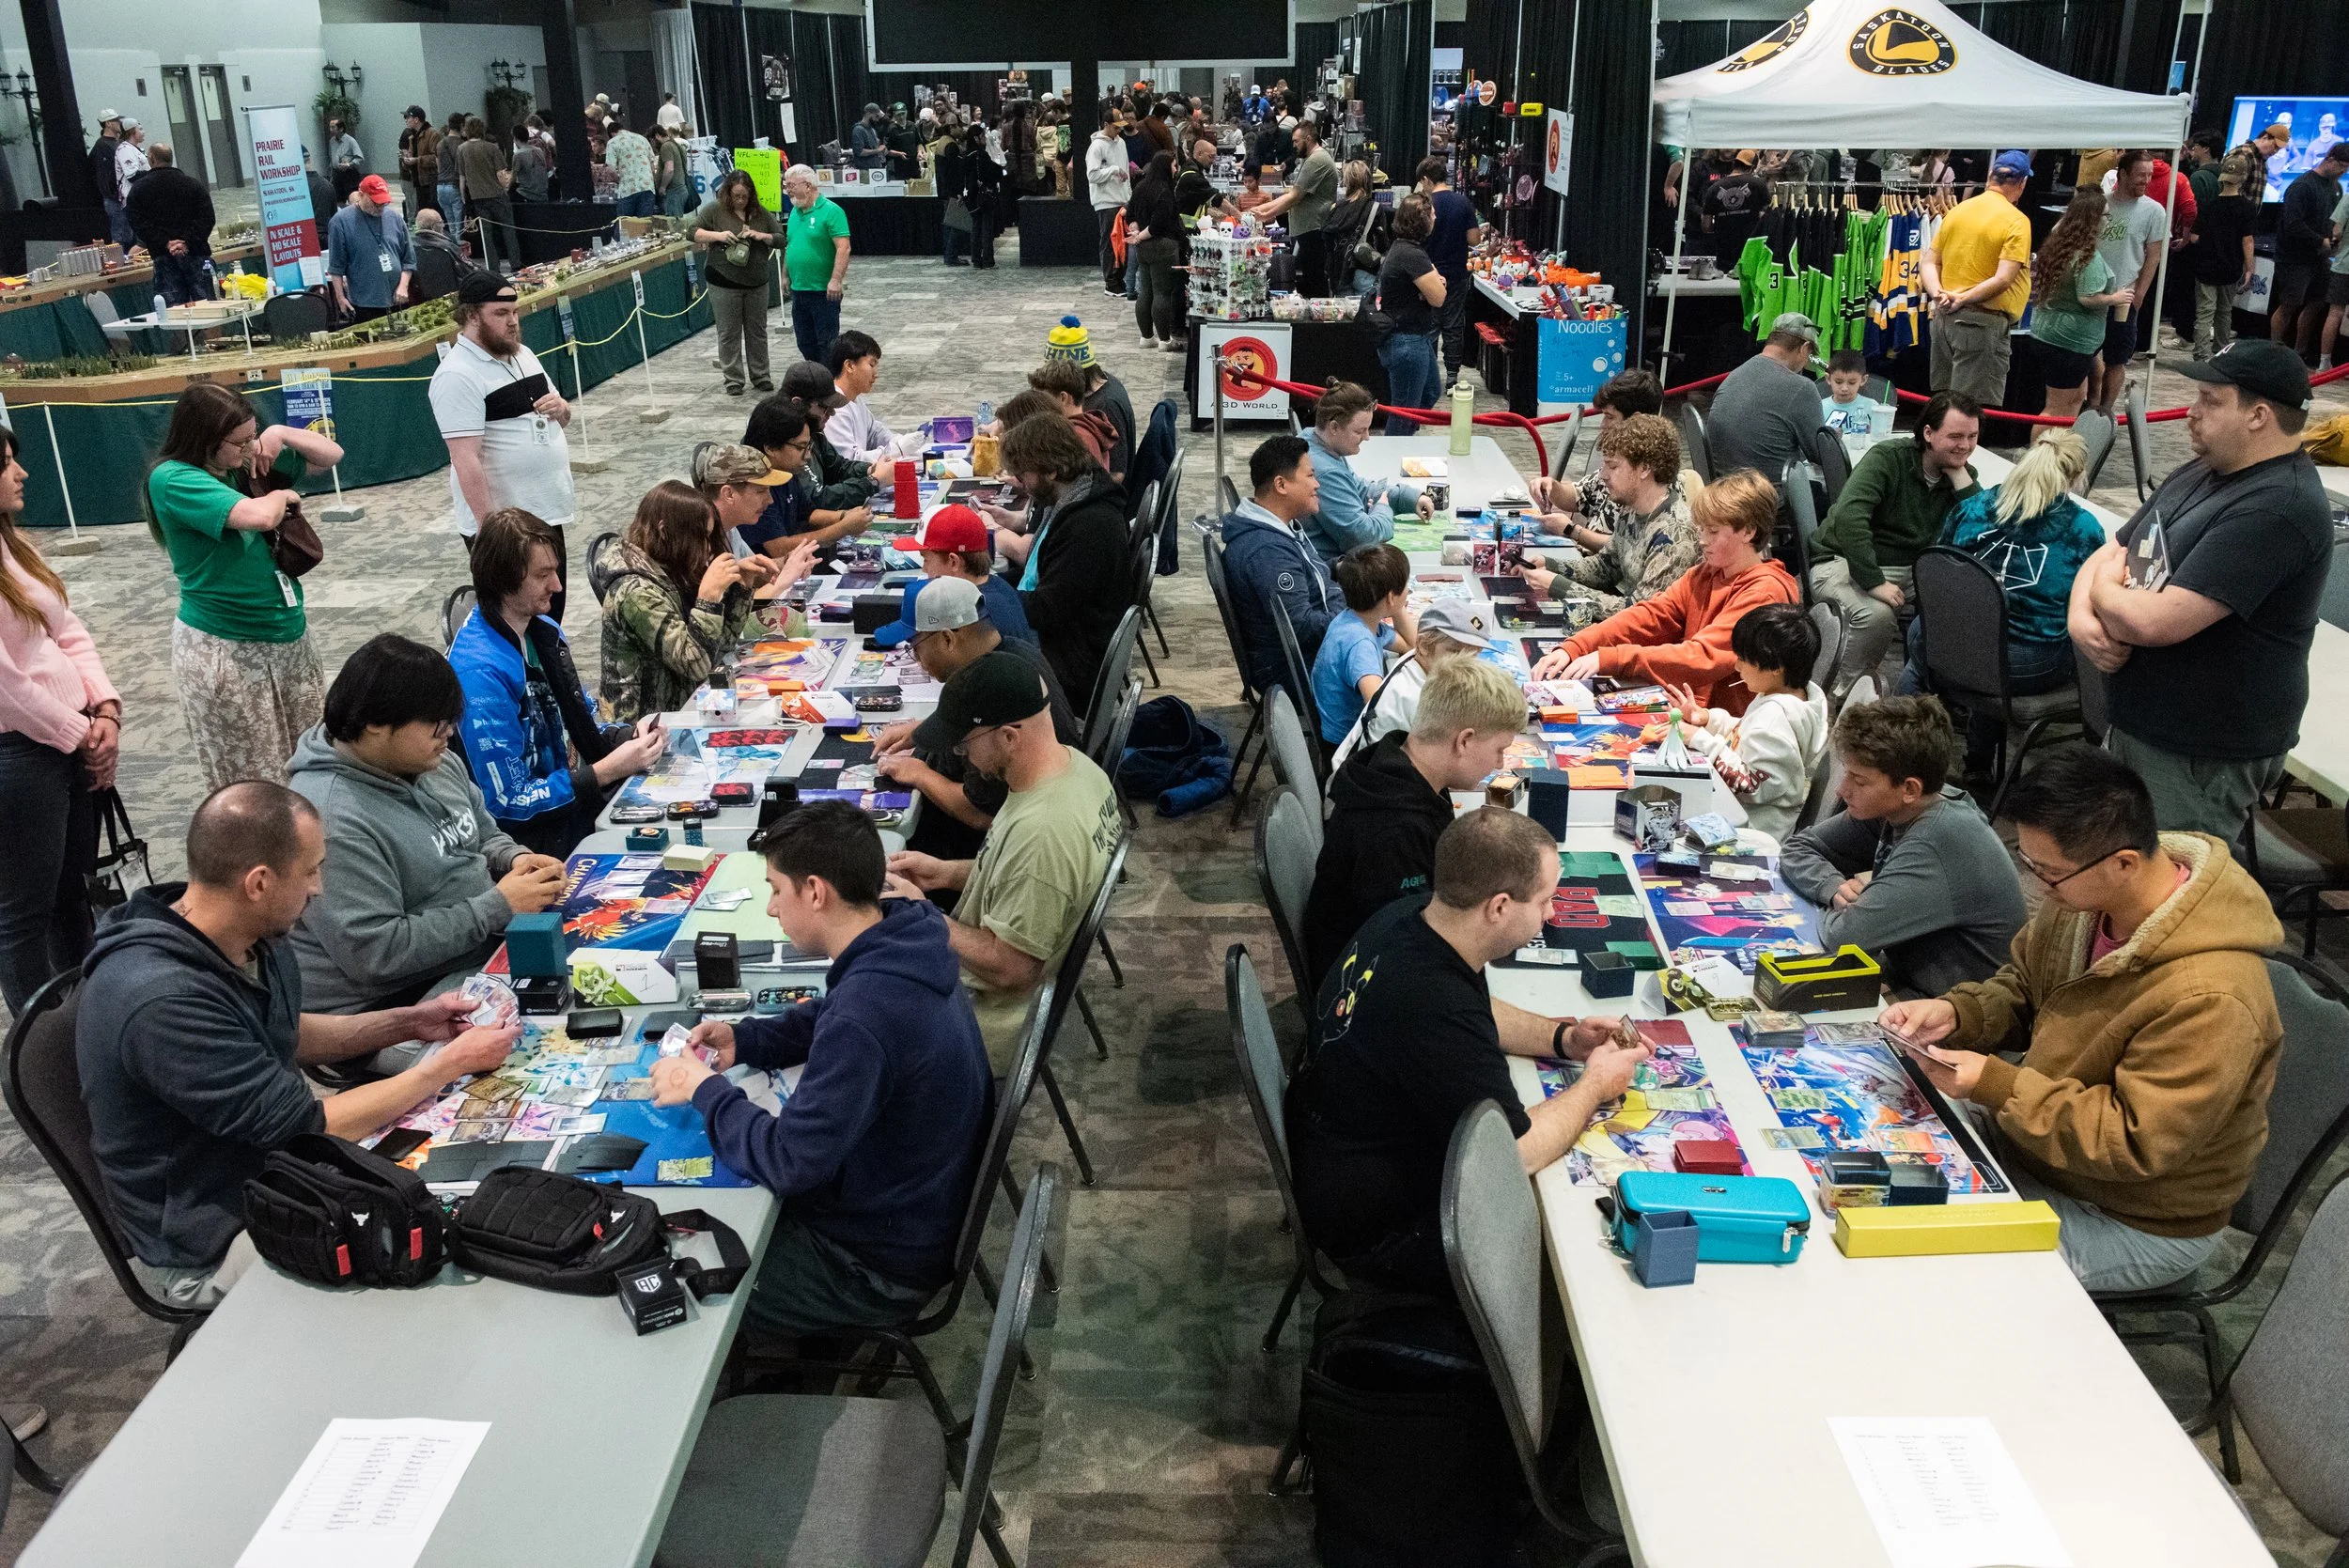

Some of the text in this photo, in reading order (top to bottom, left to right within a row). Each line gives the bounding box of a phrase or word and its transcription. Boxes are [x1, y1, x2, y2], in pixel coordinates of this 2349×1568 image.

[1852, 11, 1951, 50] SASKATOON
[1872, 59, 1951, 74] BLADES
[256, 139, 285, 152] PRAIRIE
[257, 154, 275, 166] RAIL
[259, 164, 301, 180] WORKSHOP
[270, 225, 303, 240] N SCALE &
[272, 237, 302, 251] HO SCALE
[273, 248, 302, 262] LAYOUTS
[1769, 272, 1779, 289] 3
[1558, 319, 1612, 334] Noodles
[1044, 345, 1091, 362] HINE
[1554, 384, 1594, 393] armacell
